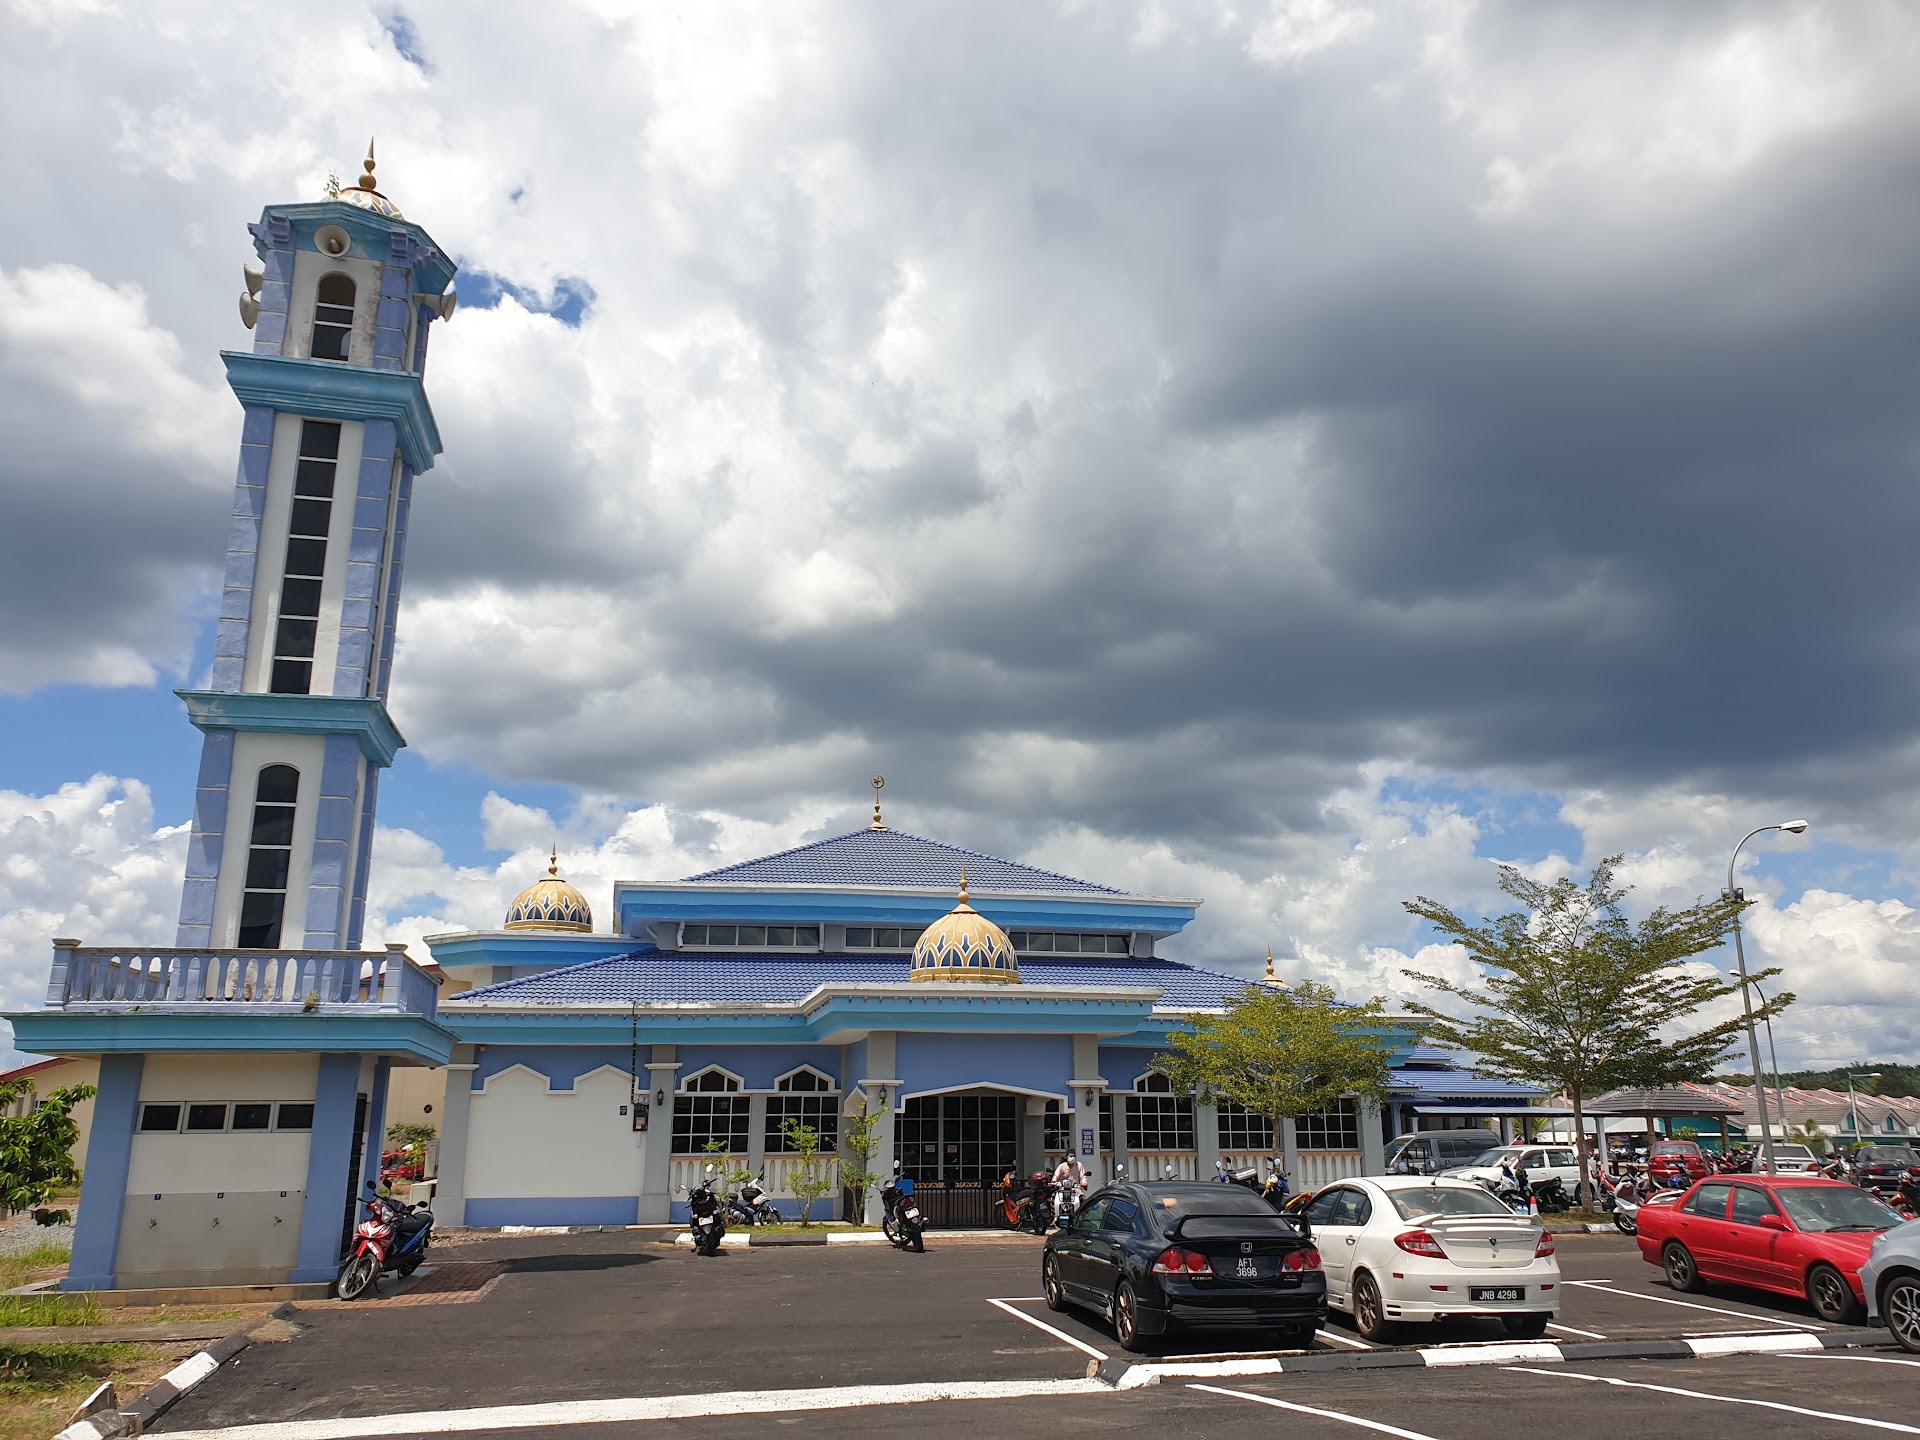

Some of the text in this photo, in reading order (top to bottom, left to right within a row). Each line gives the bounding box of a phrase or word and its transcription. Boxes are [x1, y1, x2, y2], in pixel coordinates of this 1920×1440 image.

[1238, 1257, 1253, 1268] AFT
[1236, 1267, 1258, 1277] 3696
[1479, 1290, 1517, 1300] JNB 4298
